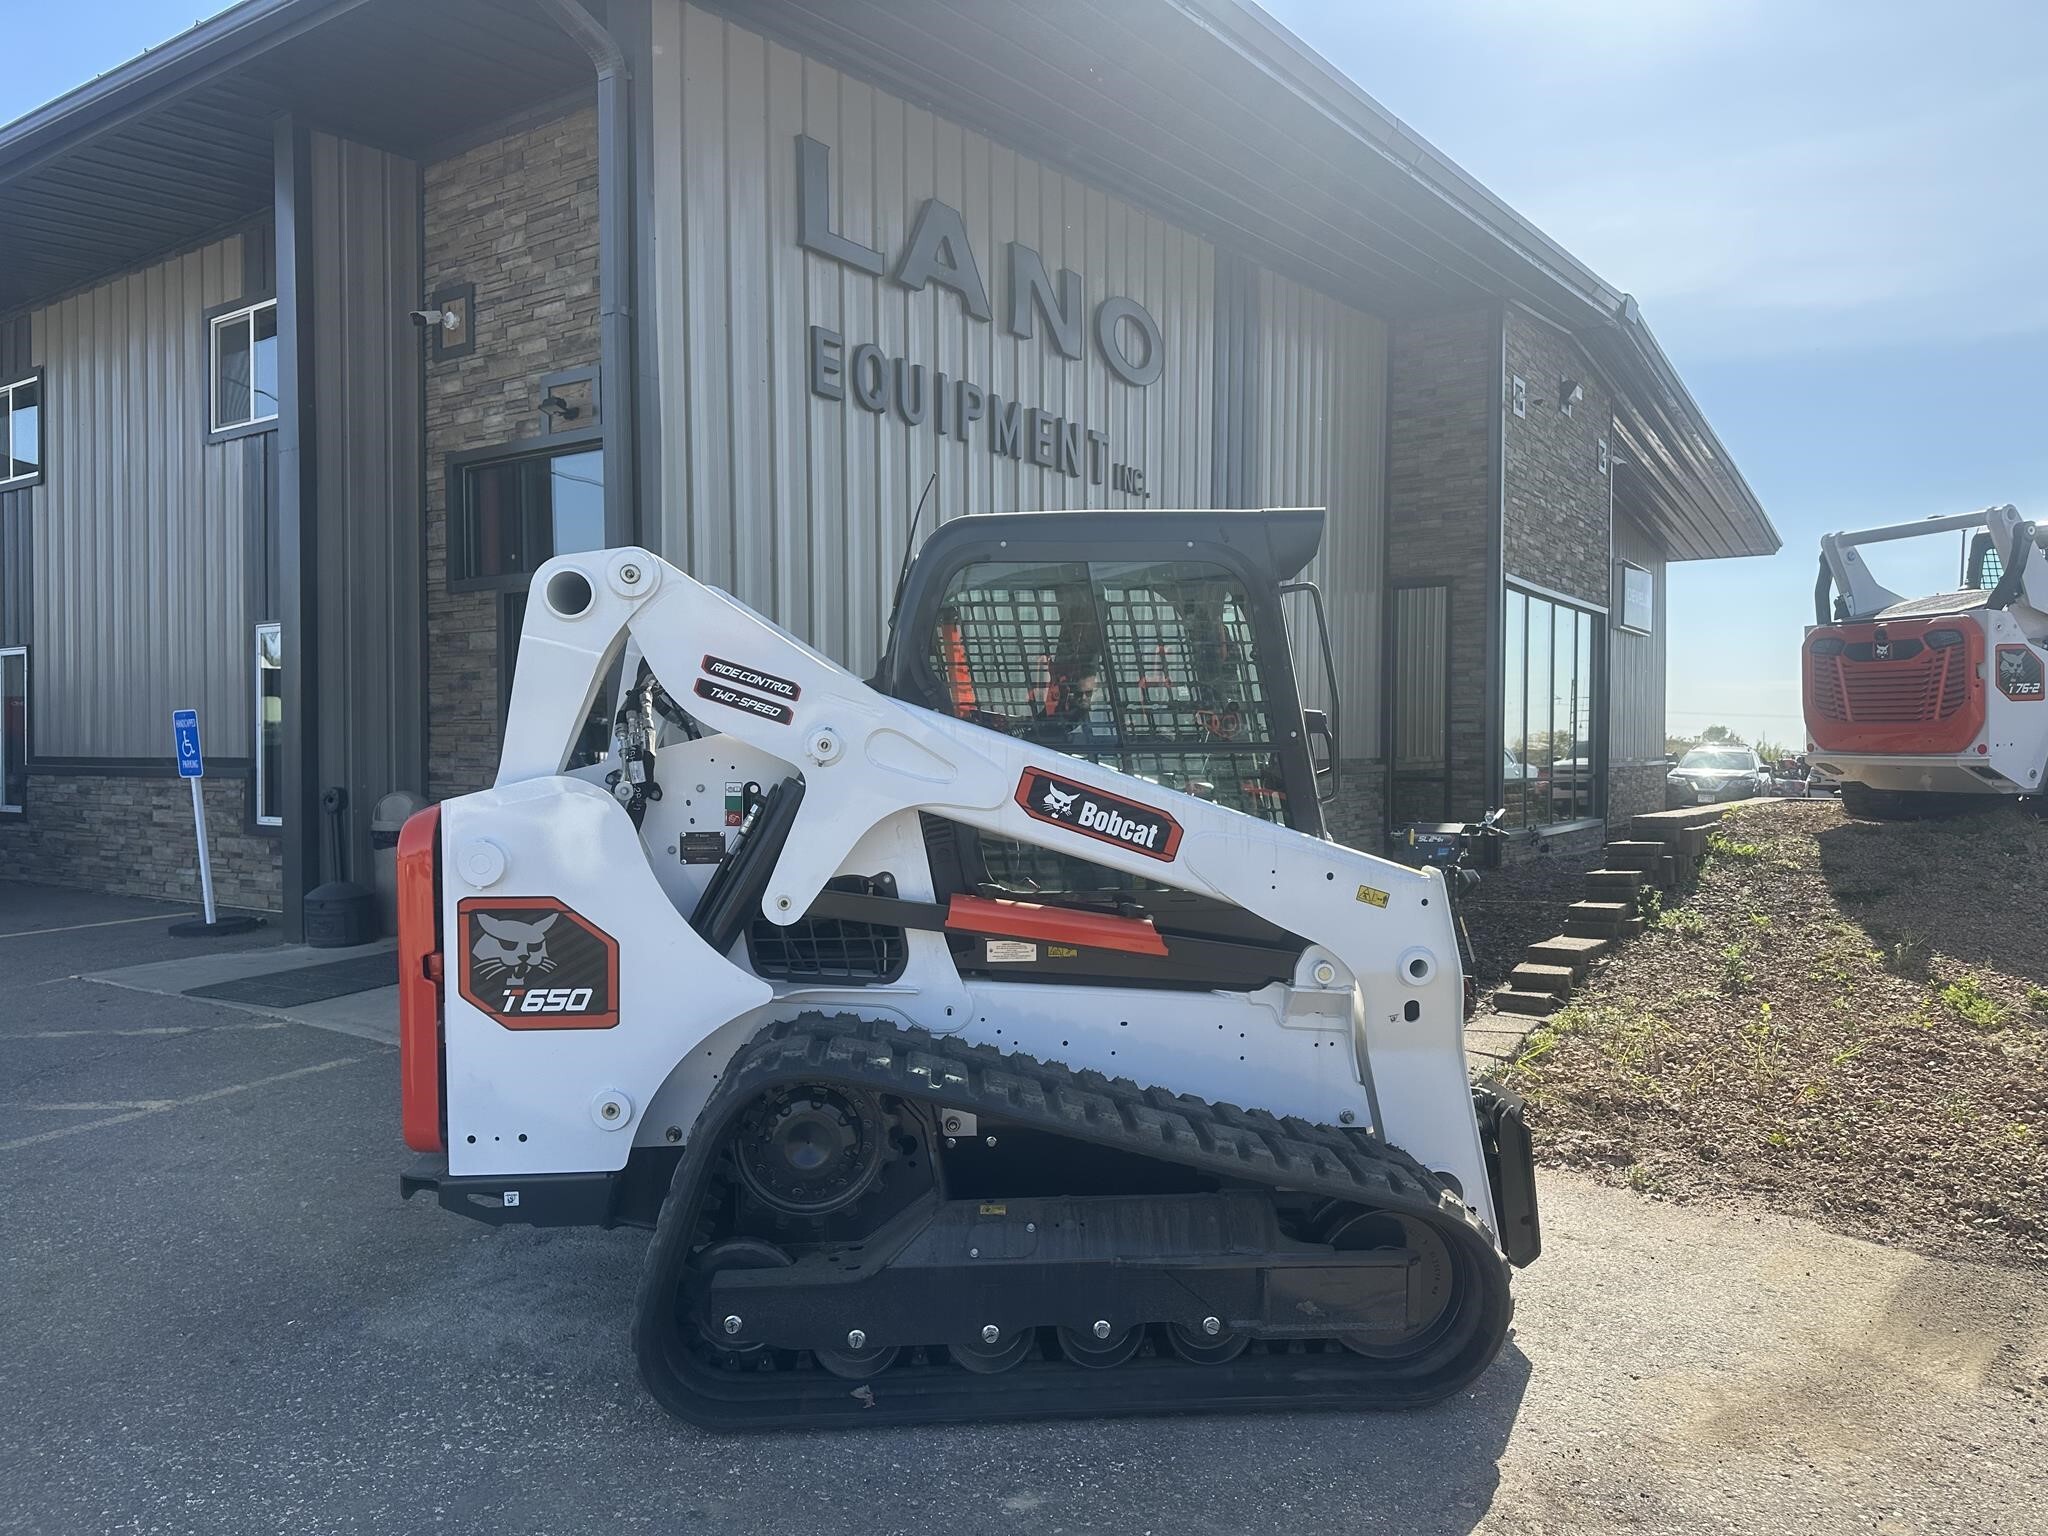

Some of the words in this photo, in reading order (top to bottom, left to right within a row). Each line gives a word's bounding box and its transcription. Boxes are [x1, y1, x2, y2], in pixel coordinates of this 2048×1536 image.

[795, 134, 1163, 387] LANO
[810, 325, 1109, 485] EQUIPMENT
[1112, 463, 1150, 498] INC.
[710, 662, 742, 678] RIDE
[741, 671, 794, 696] CONTROL
[710, 687, 782, 717] TWO-SPEED
[182, 759, 199, 768] PARKING
[1078, 801, 1158, 848] Bobcat
[502, 988, 593, 1012] T650
